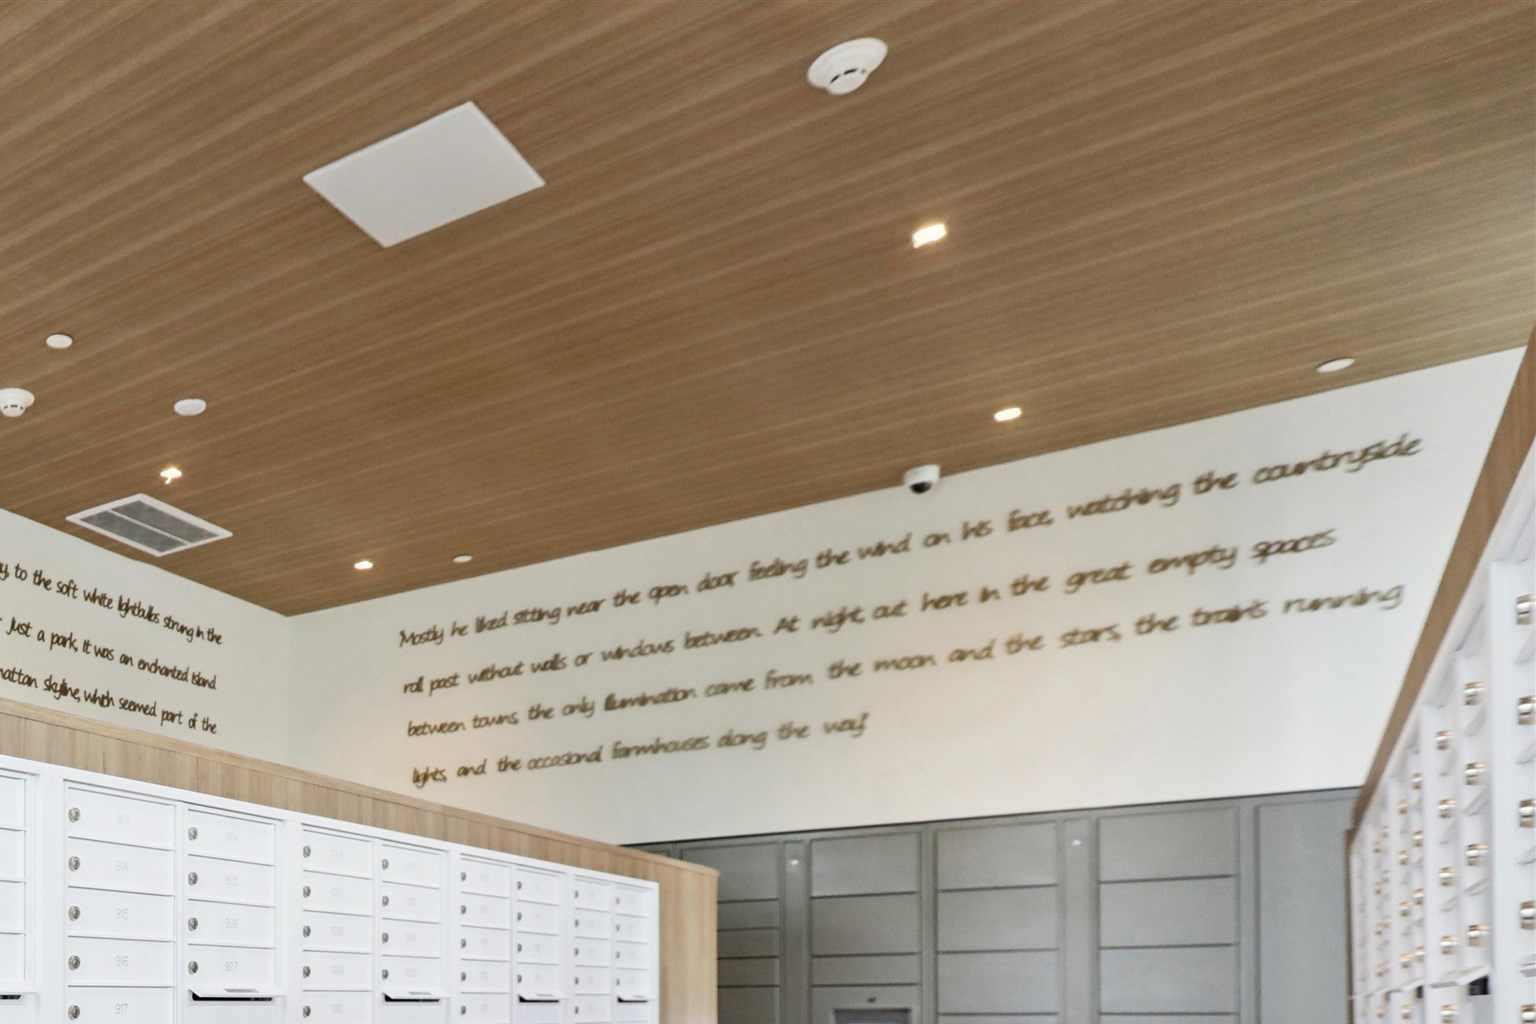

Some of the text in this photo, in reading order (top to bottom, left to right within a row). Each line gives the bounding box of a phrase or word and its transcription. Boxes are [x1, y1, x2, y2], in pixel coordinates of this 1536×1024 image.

[450, 621, 468, 636] he
[475, 611, 508, 633] liked
[513, 607, 562, 625] sitting
[566, 599, 606, 617] near
[612, 589, 641, 608] the
[647, 584, 689, 605] open
[815, 548, 850, 569] the
[857, 533, 912, 560] wind
[922, 533, 951, 548] on
[961, 520, 993, 541] his
[1067, 483, 1182, 519] watching
[1192, 471, 1238, 495] the
[1252, 433, 1422, 484] countryside
[14, 563, 27, 581] to
[33, 570, 52, 591] the
[56, 579, 78, 599] soft
[83, 588, 113, 609] white
[117, 595, 160, 624] lightbulbs
[163, 616, 194, 643] strung
[207, 628, 222, 645] the
[403, 676, 424, 694] roll
[429, 673, 460, 696] past
[468, 661, 525, 684] without
[530, 653, 567, 673] walls
[574, 652, 593, 667] or
[601, 640, 675, 661] windows
[773, 616, 800, 634] At
[872, 600, 908, 620] out
[920, 591, 968, 612] here
[1010, 574, 1050, 596] the
[1065, 562, 1133, 594] great
[1147, 545, 1238, 575] empty
[1250, 529, 1336, 564] spaces
[37, 630, 45, 642] a
[50, 632, 78, 652] park,
[94, 645, 114, 661] was
[120, 654, 133, 666] an
[138, 659, 189, 682] enchanted
[407, 721, 466, 737] between
[528, 704, 554, 720] the
[562, 696, 595, 718] only
[705, 678, 754, 697] came
[765, 669, 813, 689] from
[827, 660, 861, 679] the
[874, 655, 936, 672] moon
[948, 640, 995, 662] and
[1005, 634, 1043, 655] the
[1134, 613, 1179, 635] the
[1283, 585, 1404, 613] running
[84, 689, 115, 708] which
[119, 698, 157, 717] seemed
[161, 710, 183, 726] part
[188, 713, 198, 729] of
[202, 717, 216, 734] the
[457, 759, 487, 777] and
[497, 756, 522, 773] the
[527, 745, 603, 770] occasional
[612, 736, 710, 759] farmhouses
[716, 730, 768, 750] along
[777, 722, 809, 740] the
